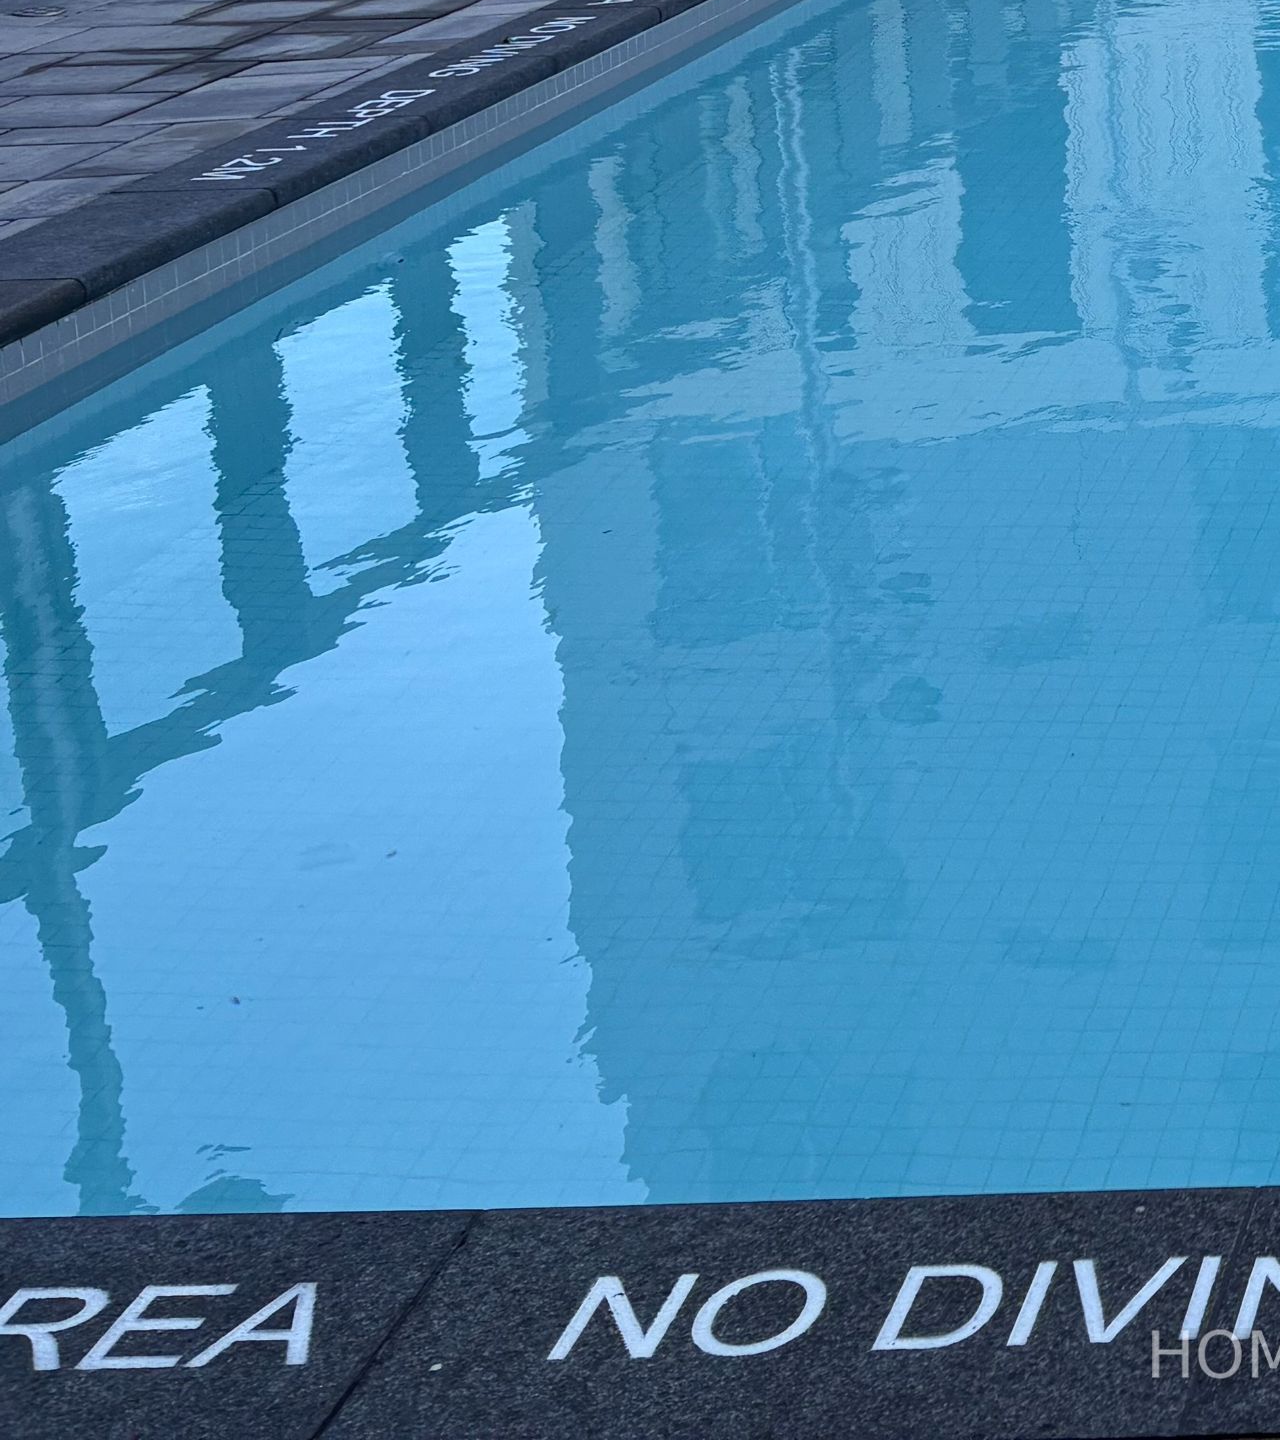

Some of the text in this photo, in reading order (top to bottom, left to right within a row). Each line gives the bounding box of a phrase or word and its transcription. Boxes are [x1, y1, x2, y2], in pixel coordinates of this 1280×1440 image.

[530, 16, 597, 34] NO
[428, 34, 556, 78] DIVING
[286, 89, 436, 140] DEPTH
[190, 145, 308, 181] 1.2M
[548, 1269, 827, 1360] NO
